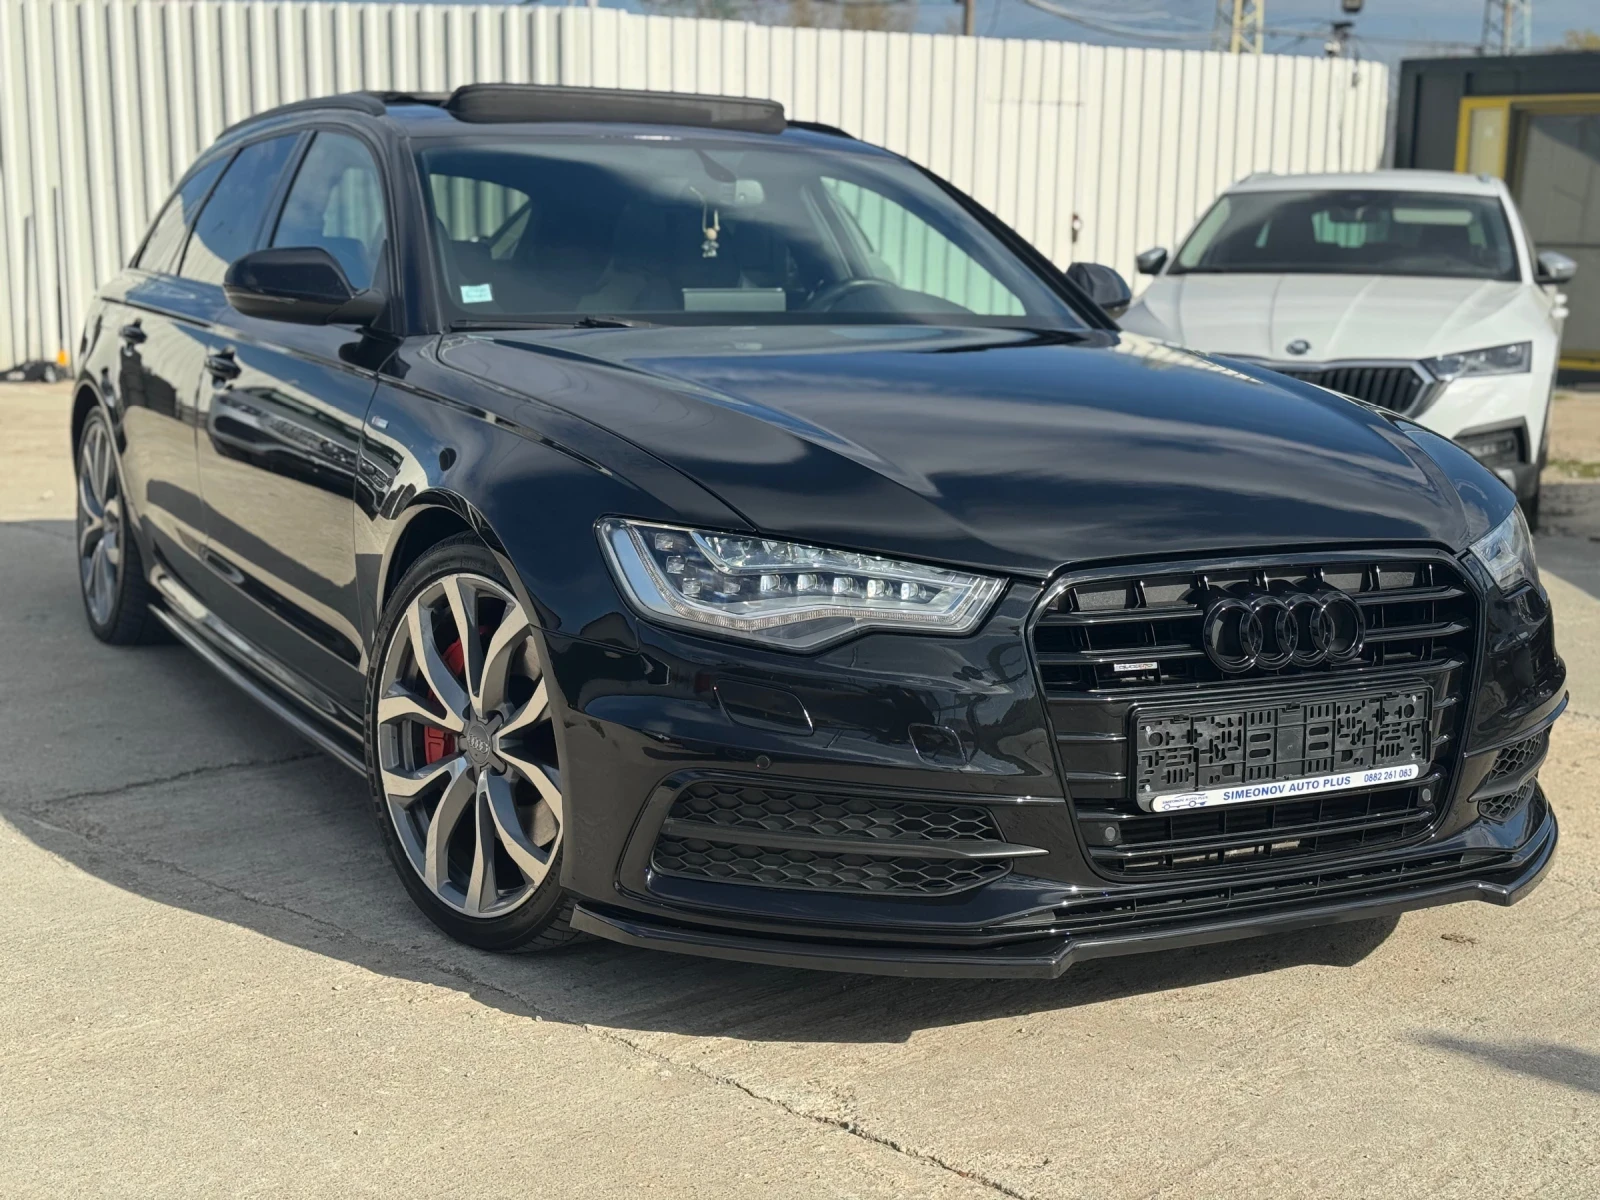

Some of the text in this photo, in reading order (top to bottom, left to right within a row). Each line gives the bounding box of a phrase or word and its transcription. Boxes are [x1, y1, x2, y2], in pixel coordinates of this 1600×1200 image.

[1383, 769, 1397, 780] 261
[1223, 776, 1351, 801] SIMEONOV AUTO PLUS
